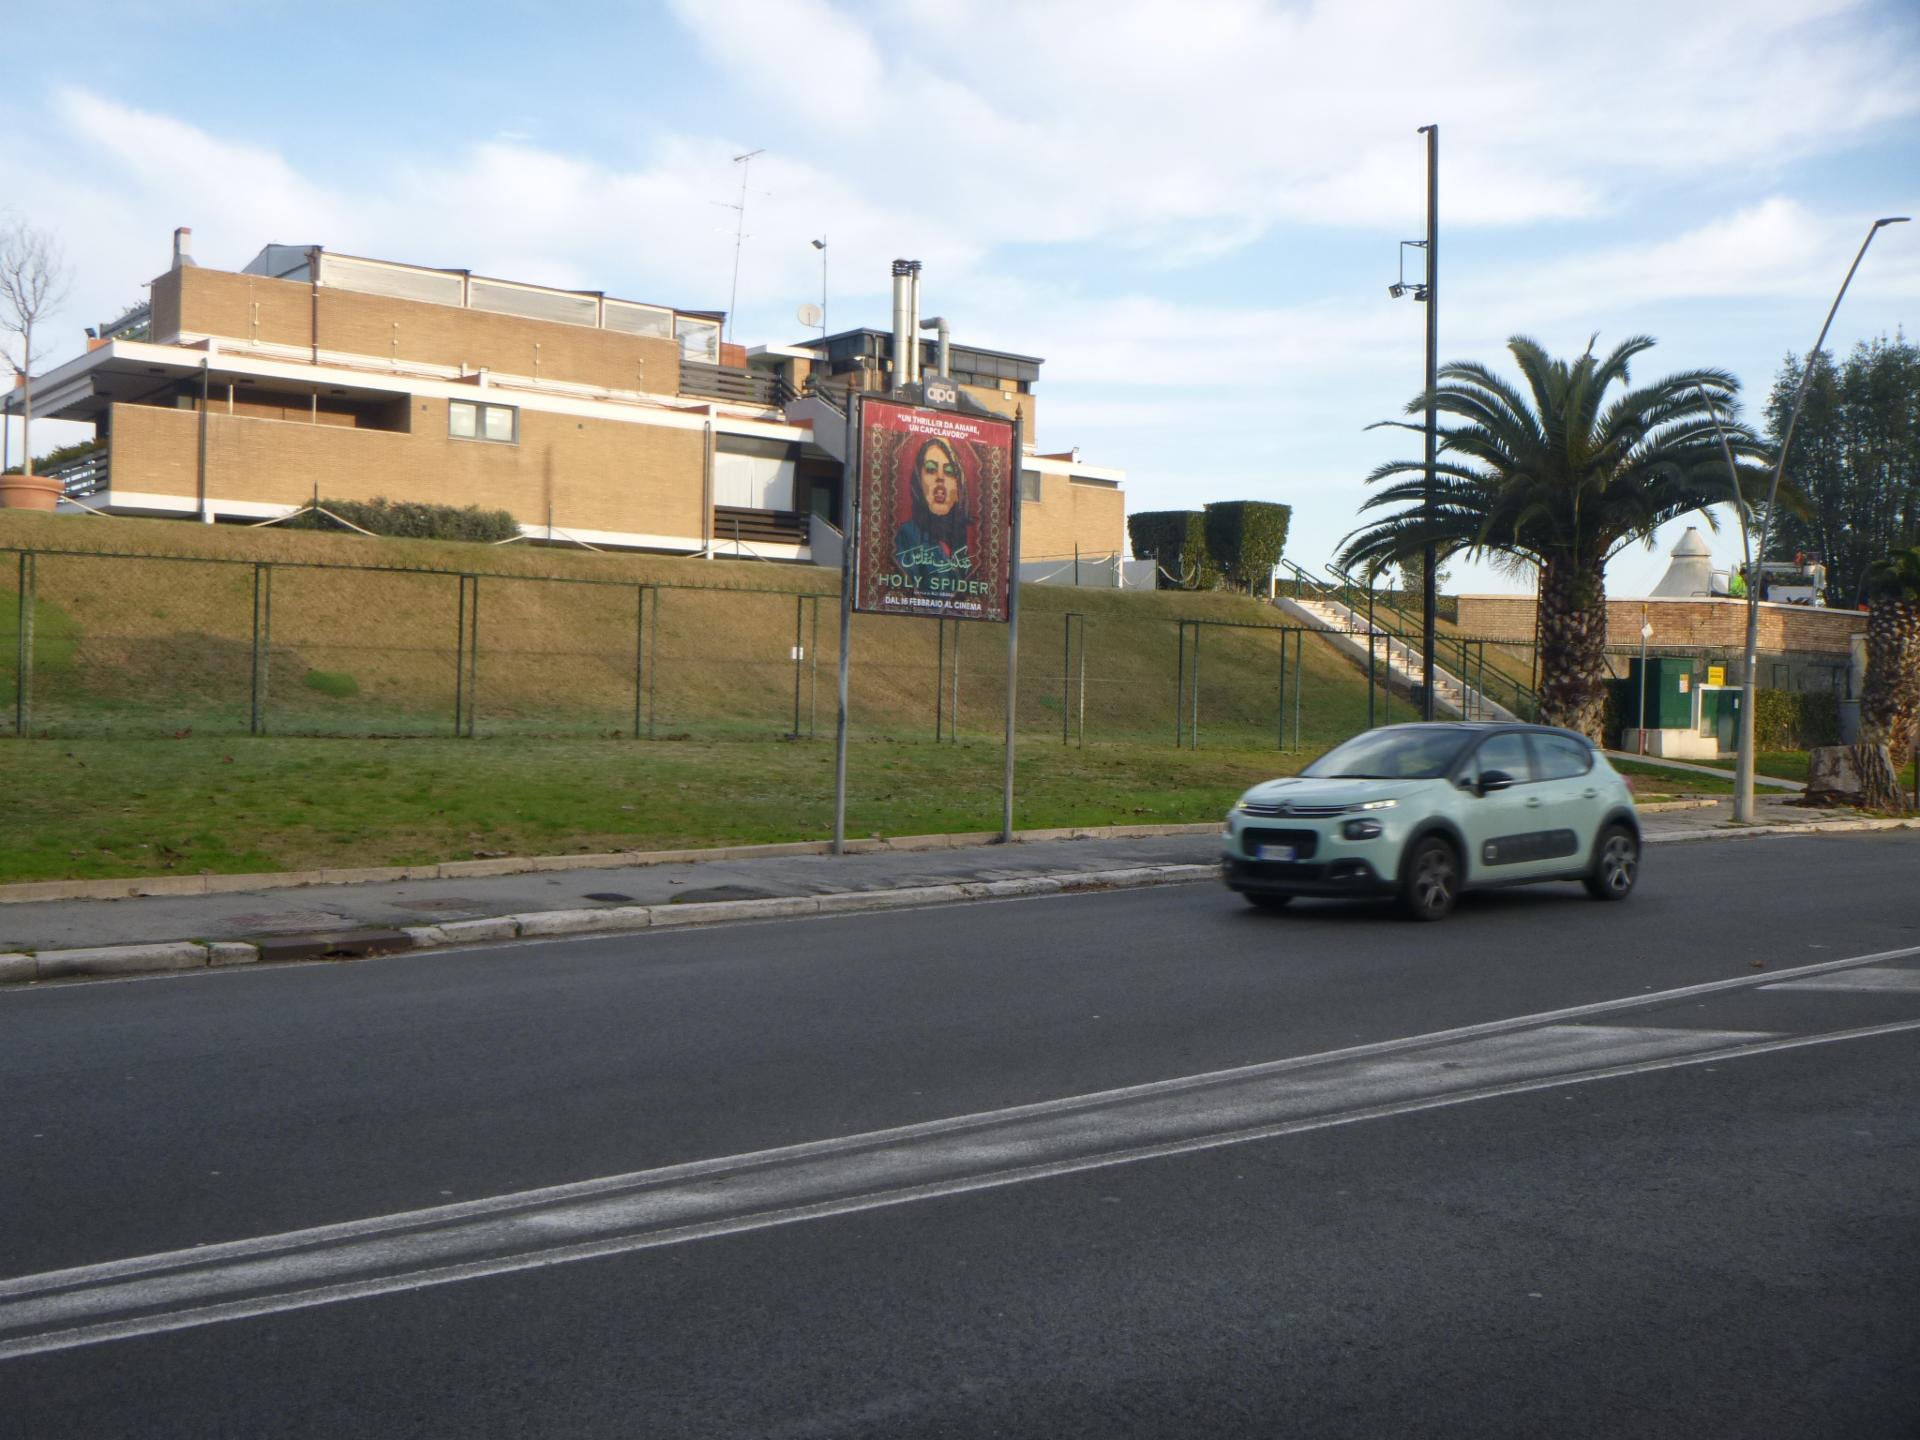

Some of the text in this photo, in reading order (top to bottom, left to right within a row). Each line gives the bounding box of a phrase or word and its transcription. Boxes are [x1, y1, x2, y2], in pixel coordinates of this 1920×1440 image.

[909, 423, 920, 432] UN
[912, 416, 943, 428] THRILLER
[944, 421, 954, 429] DA
[878, 573, 990, 595] HOLY SPIDER
[885, 596, 900, 605] DAL
[909, 598, 942, 608] FEBBRAIO
[944, 600, 953, 609] AL
[954, 601, 982, 611] CINEMA
